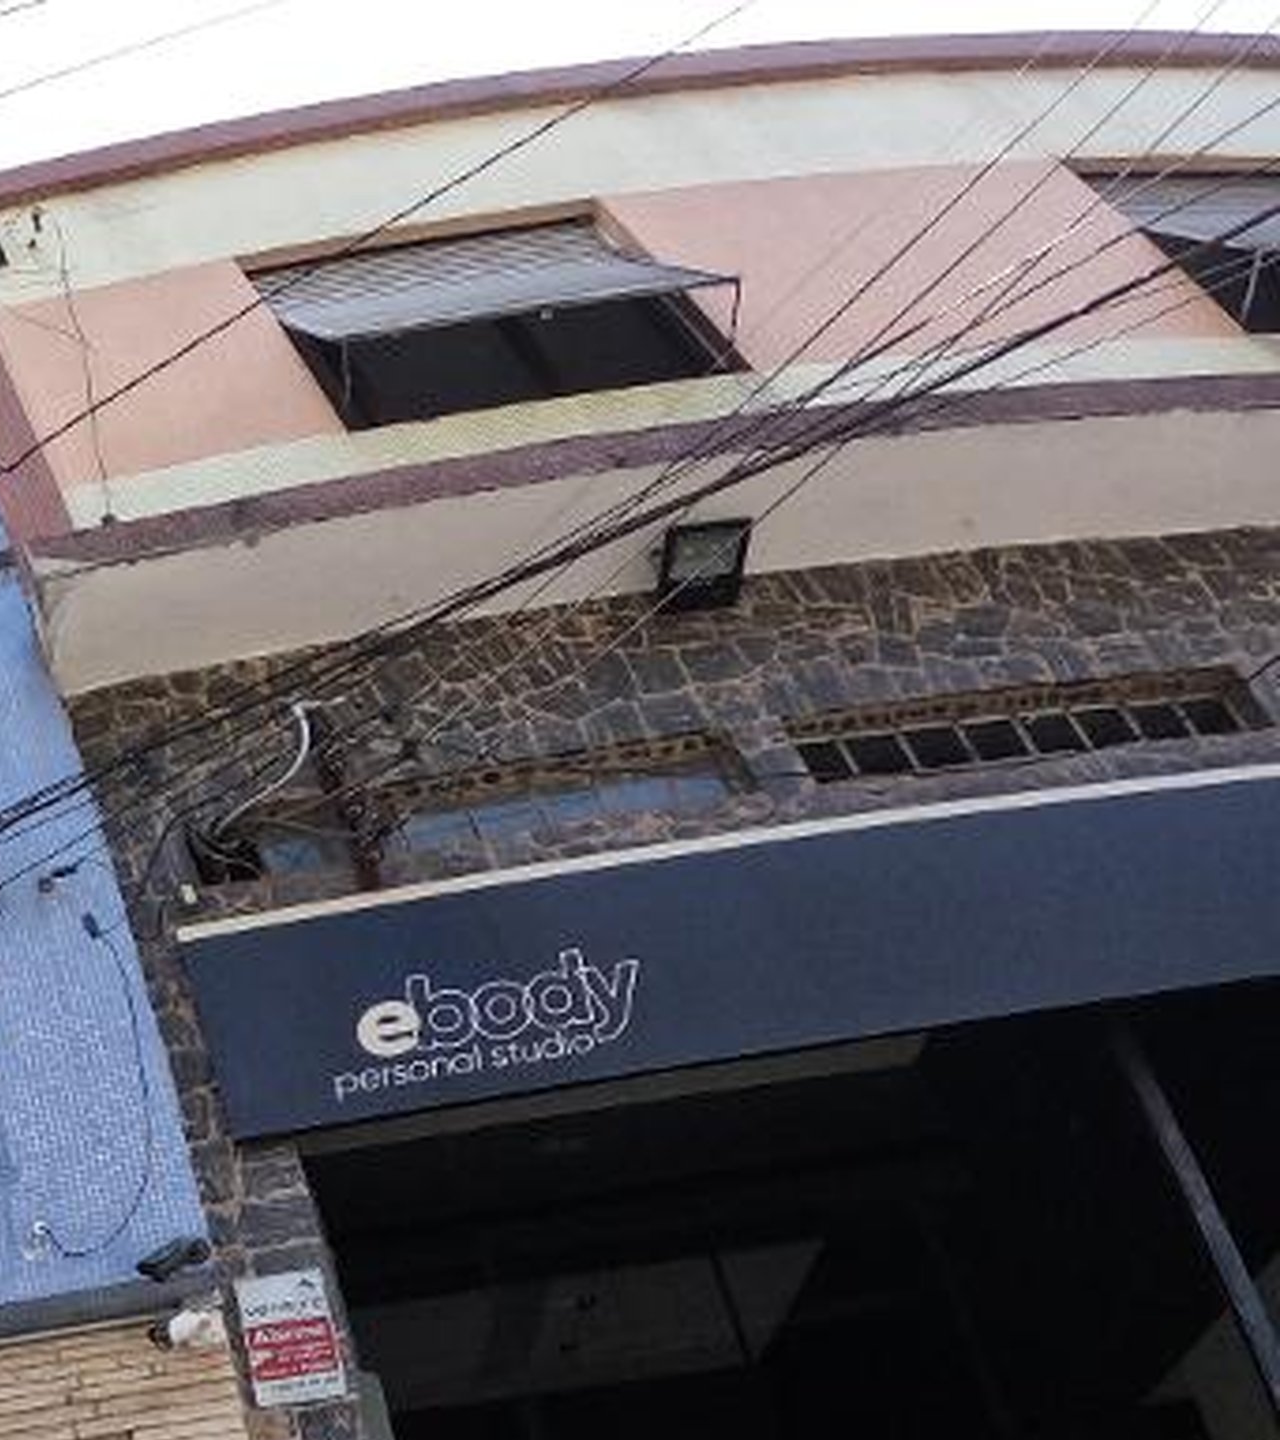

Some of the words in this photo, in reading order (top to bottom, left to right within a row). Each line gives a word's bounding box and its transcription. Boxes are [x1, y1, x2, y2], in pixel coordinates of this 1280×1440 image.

[355, 947, 640, 1058] ebody
[332, 1046, 484, 1104] personal
[490, 1031, 596, 1071] studio
